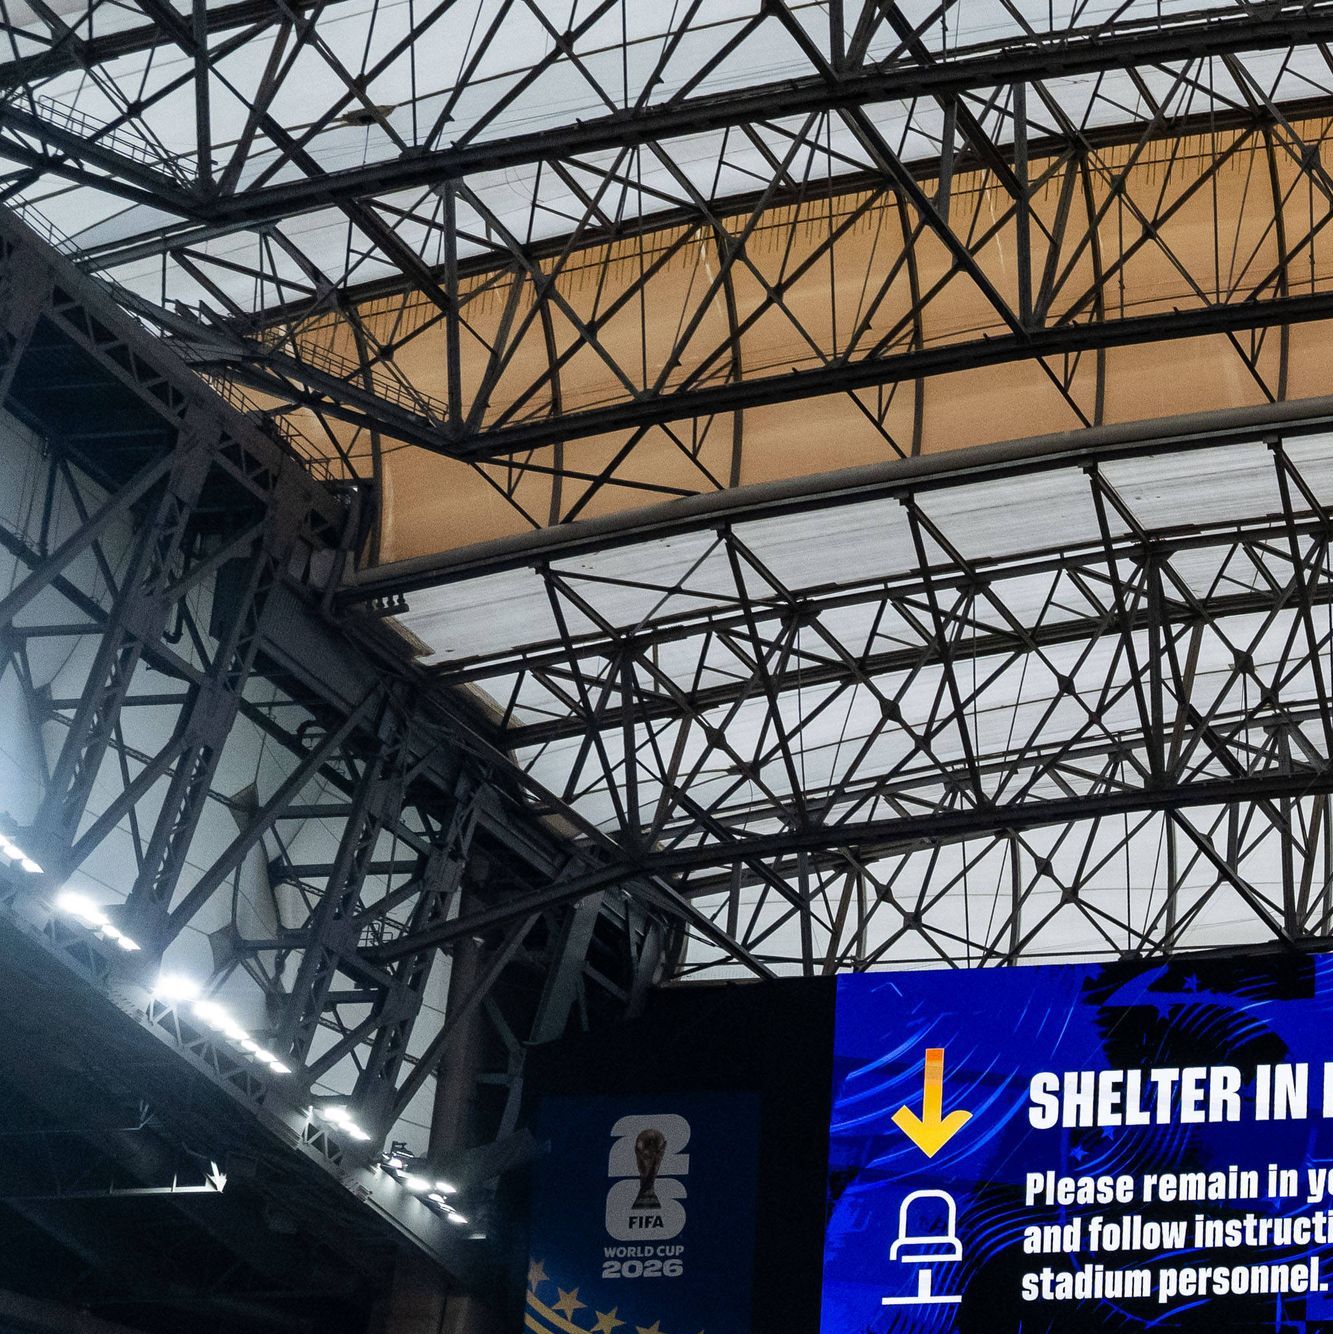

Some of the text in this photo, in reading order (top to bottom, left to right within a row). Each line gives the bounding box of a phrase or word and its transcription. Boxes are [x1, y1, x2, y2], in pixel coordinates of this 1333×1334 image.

[1029, 1066, 1241, 1129] SHELTER
[1256, 1063, 1309, 1120] IN
[1026, 1171, 1133, 1205] Please
[1144, 1166, 1258, 1201] remain
[1269, 1164, 1297, 1197] in
[629, 1217, 664, 1228] FIFA
[1024, 1218, 1081, 1253] and
[1089, 1215, 1187, 1251] follow
[602, 1259, 684, 1279] 2026
[604, 1245, 685, 1258] WORLD CUP
[1022, 1257, 1328, 1303] stadium personnel.
